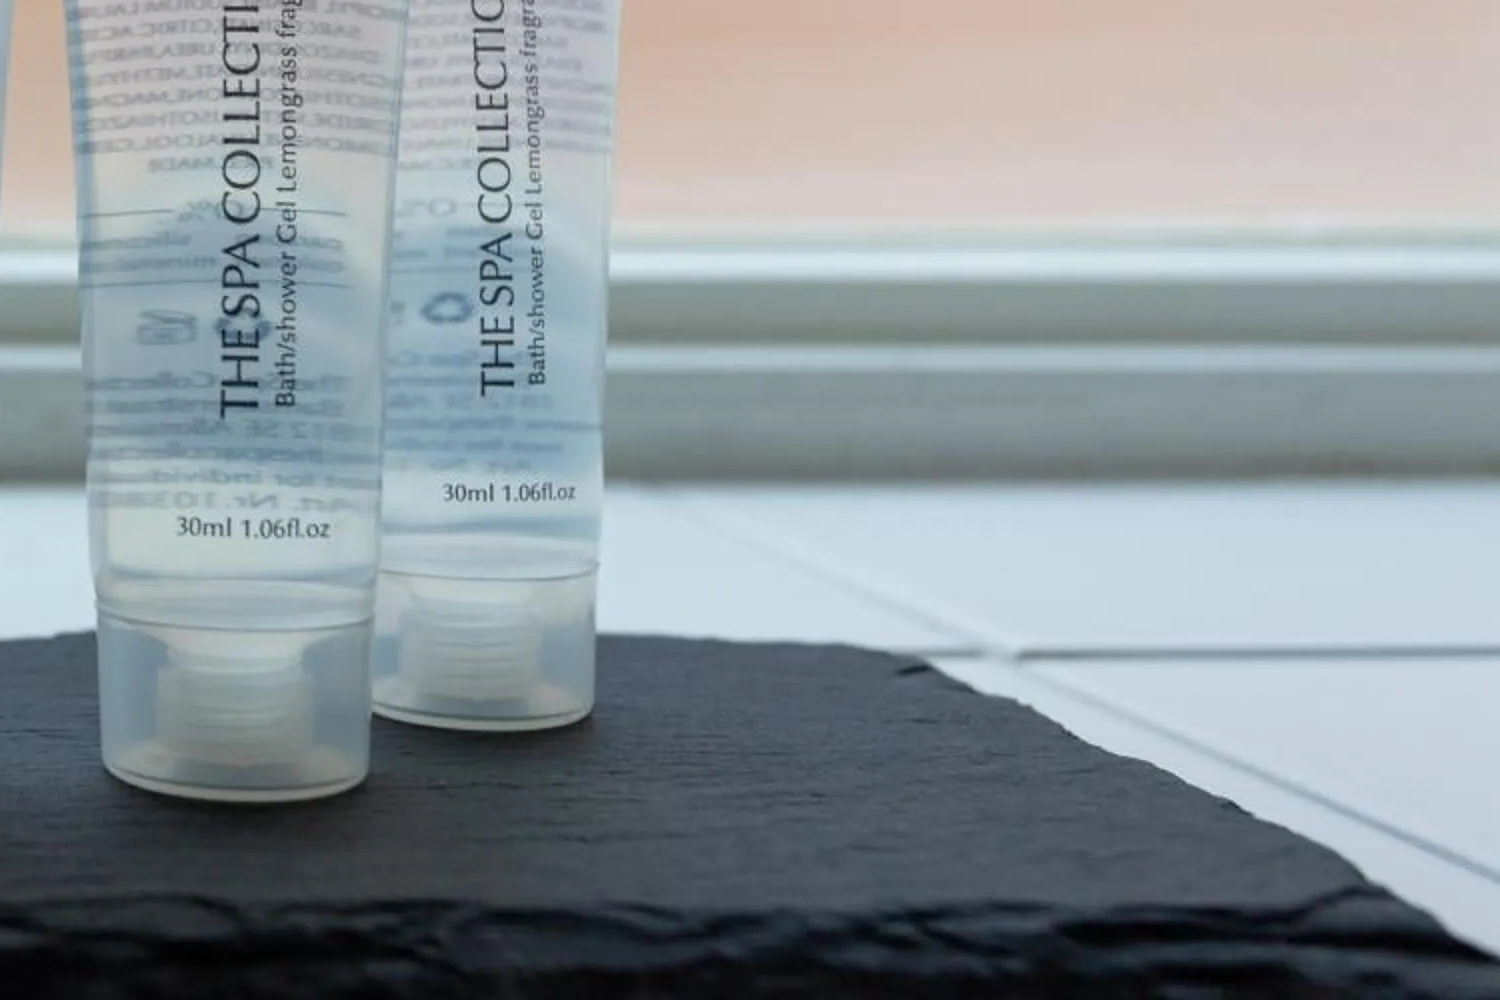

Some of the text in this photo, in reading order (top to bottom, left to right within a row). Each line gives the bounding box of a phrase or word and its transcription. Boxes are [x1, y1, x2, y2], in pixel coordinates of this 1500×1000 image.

[275, 46, 304, 193] Lemongrass
[525, 64, 545, 195] Lemongrass
[275, 201, 298, 245] Gel
[523, 202, 543, 240] Gel
[221, 234, 261, 319] SPA
[479, 231, 515, 307] SPA
[275, 251, 297, 407] Bath/shower
[479, 315, 516, 397] THE
[527, 247, 546, 386] Bath/shower
[219, 327, 261, 419] THE
[175, 517, 331, 539] 30ml 1.06fl.oz
[446, 483, 576, 502] 30ml 1.06fl.oz
